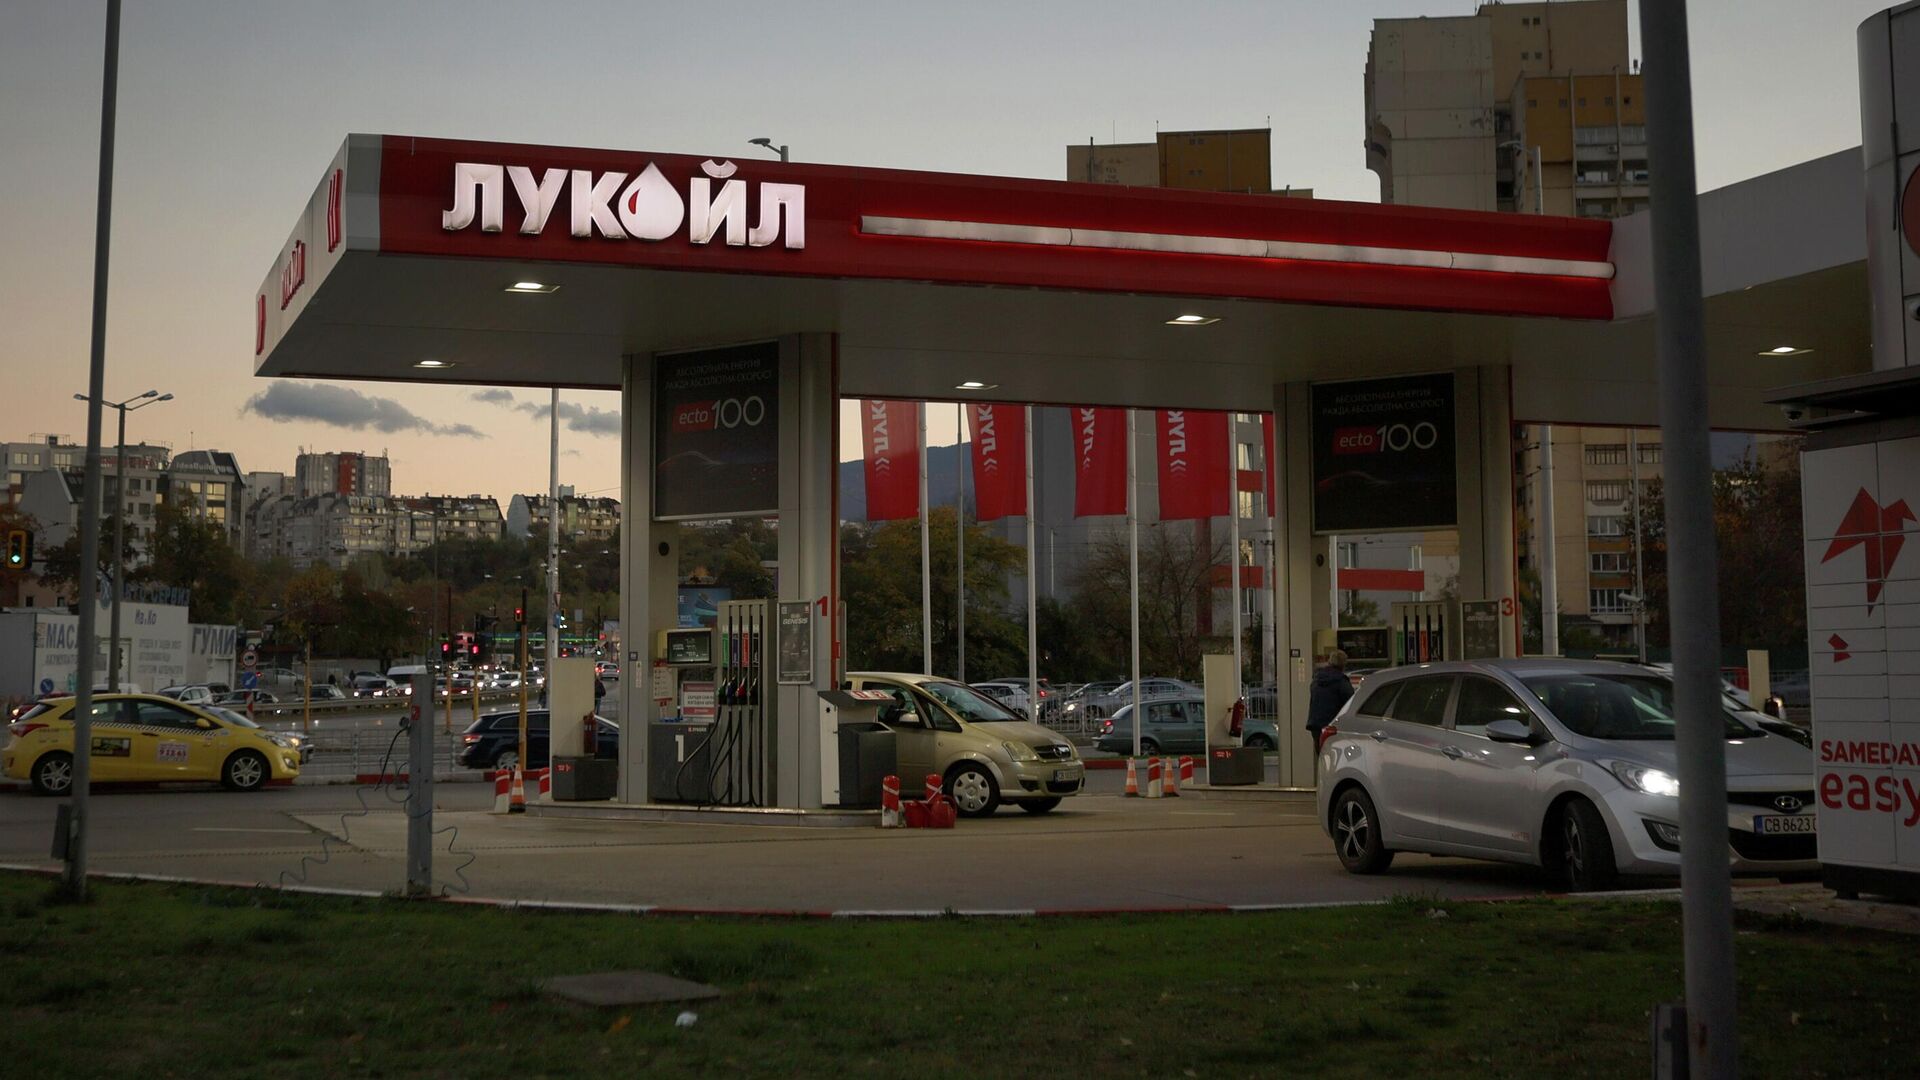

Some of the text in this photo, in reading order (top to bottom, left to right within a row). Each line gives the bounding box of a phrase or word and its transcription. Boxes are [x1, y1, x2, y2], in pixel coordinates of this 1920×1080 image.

[871, 400, 889, 455] ЛУК
[816, 596, 828, 617] 1
[1501, 598, 1514, 617] 3
[46, 623, 80, 650] МАС
[192, 626, 236, 655] ГУМИ
[675, 735, 684, 762] 1
[1821, 740, 1920, 766] SAMEDAY
[1820, 773, 1920, 827] easy
[1783, 818, 1811, 832] 8623
